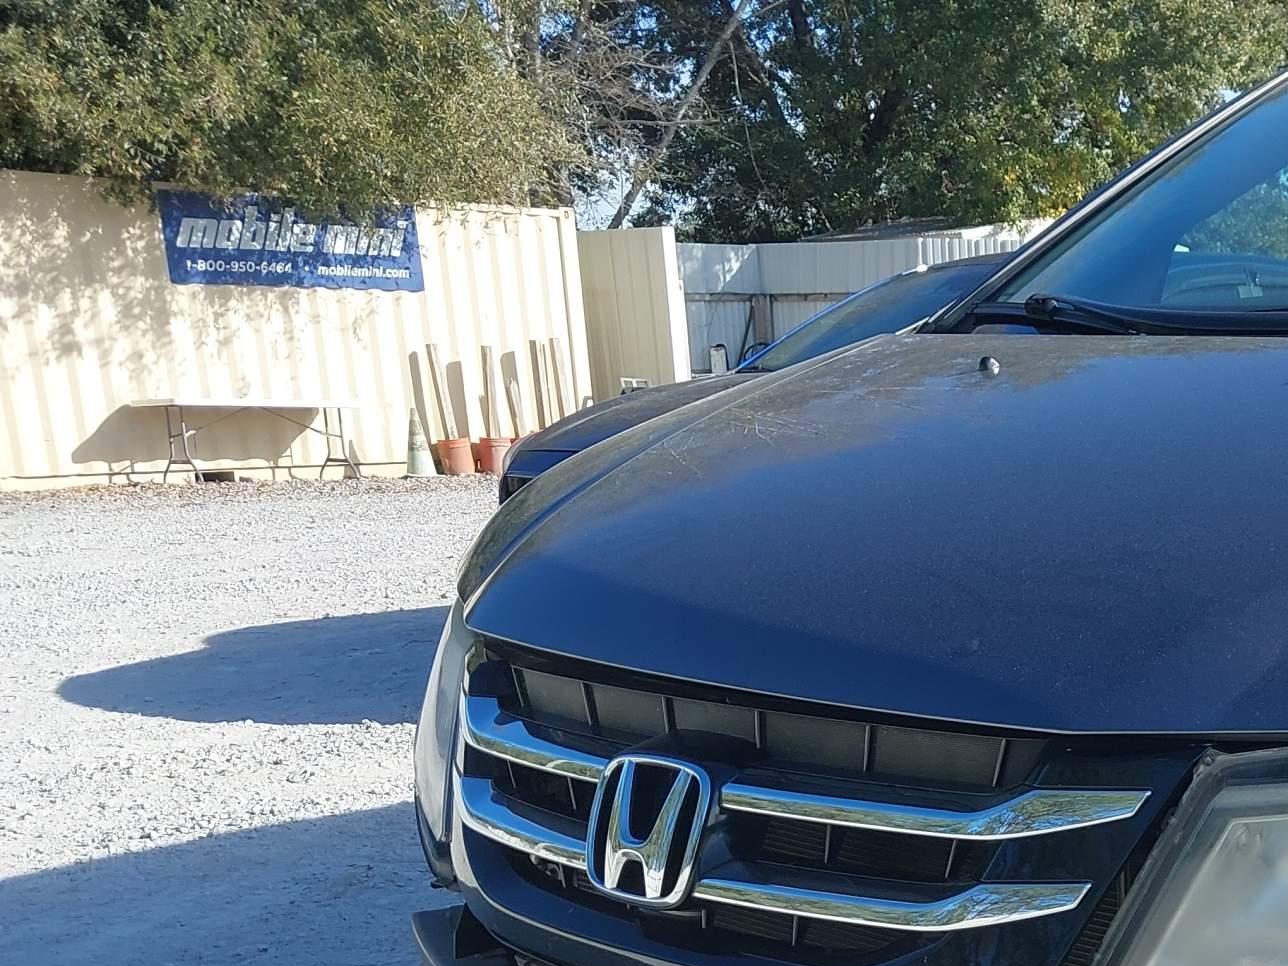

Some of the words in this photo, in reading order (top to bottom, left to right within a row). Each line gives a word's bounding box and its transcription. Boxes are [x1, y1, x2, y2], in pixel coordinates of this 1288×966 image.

[176, 205, 316, 253] mobile
[323, 218, 409, 257] mini
[185, 259, 293, 274] 1-800-950-6464
[318, 264, 410, 278] mobilemini.com
